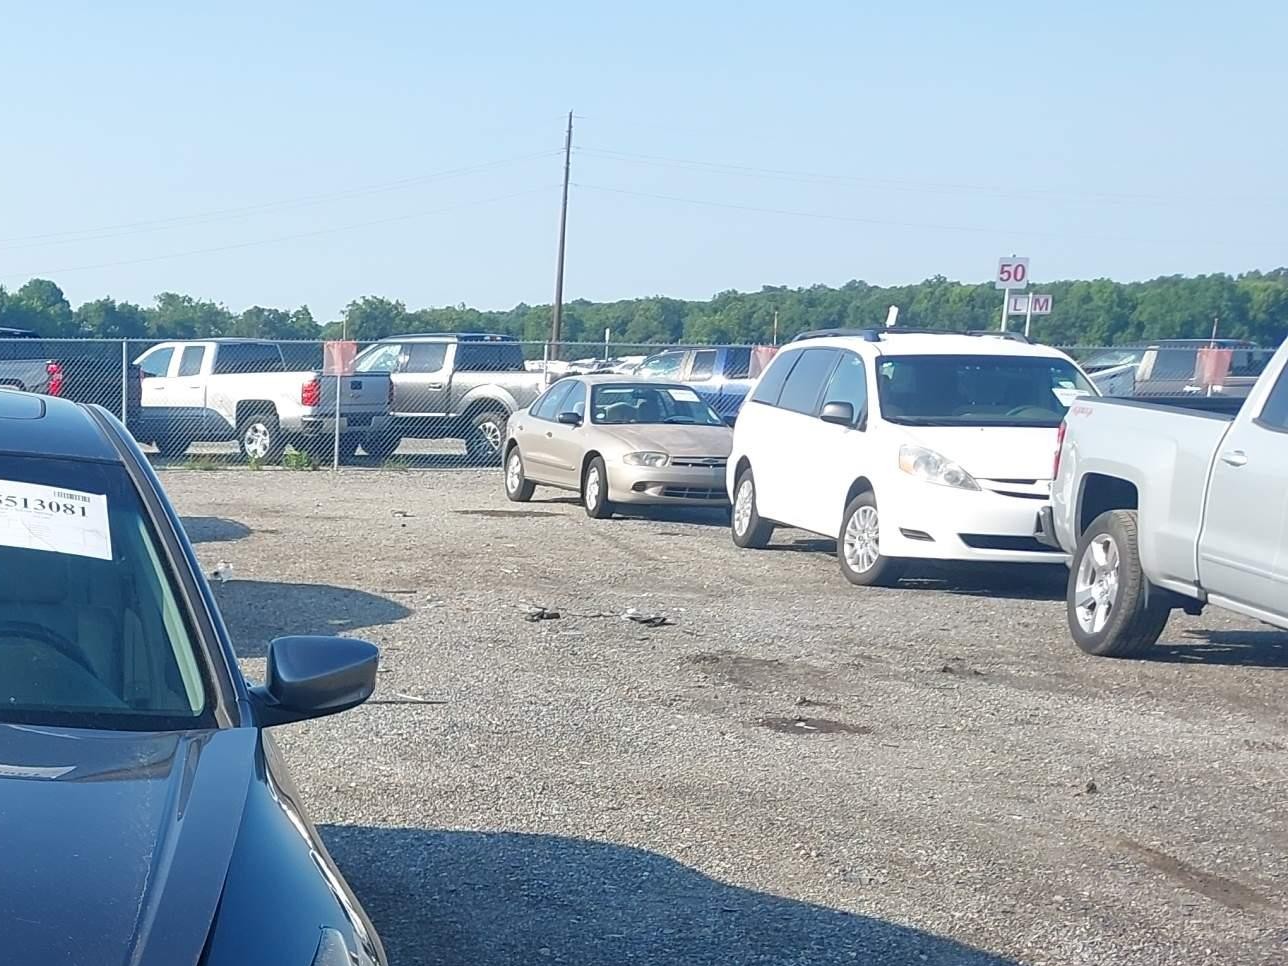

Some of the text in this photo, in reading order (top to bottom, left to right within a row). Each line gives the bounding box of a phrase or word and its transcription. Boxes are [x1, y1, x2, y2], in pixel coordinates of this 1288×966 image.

[999, 263, 1026, 282] 50
[1013, 298, 1049, 312] L M
